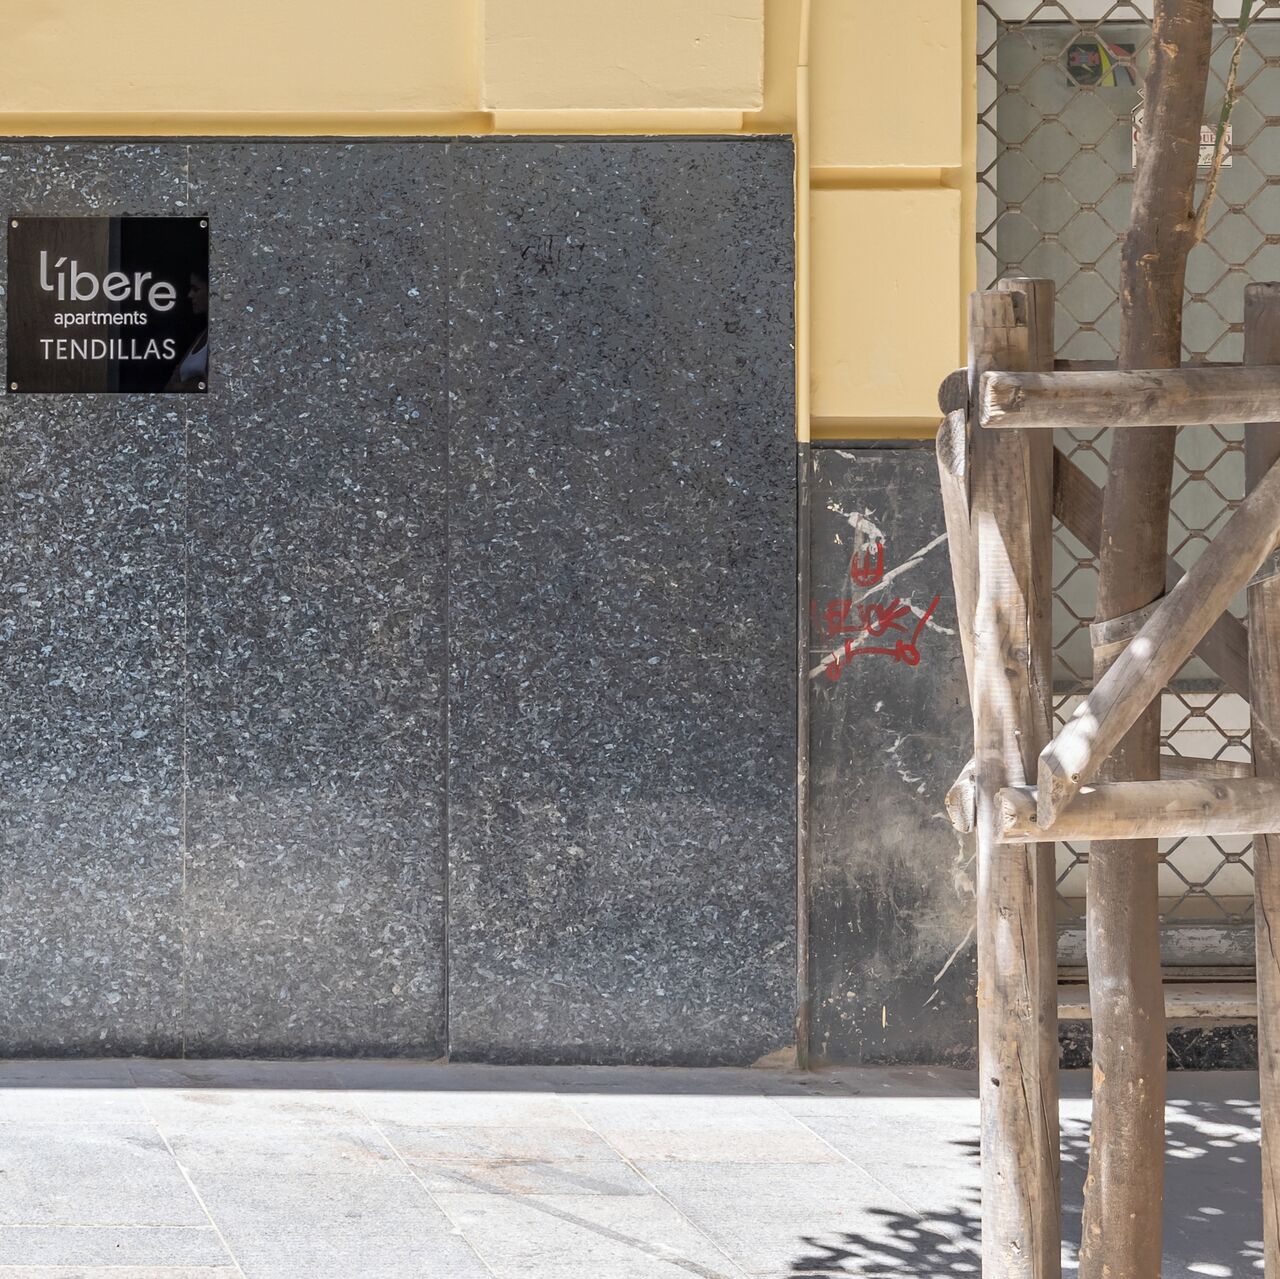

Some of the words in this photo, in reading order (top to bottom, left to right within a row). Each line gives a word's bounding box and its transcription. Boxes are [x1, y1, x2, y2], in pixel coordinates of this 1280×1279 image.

[39, 250, 177, 312] líbere
[53, 310, 148, 329] apartments
[39, 338, 176, 360] TENDILLAS
